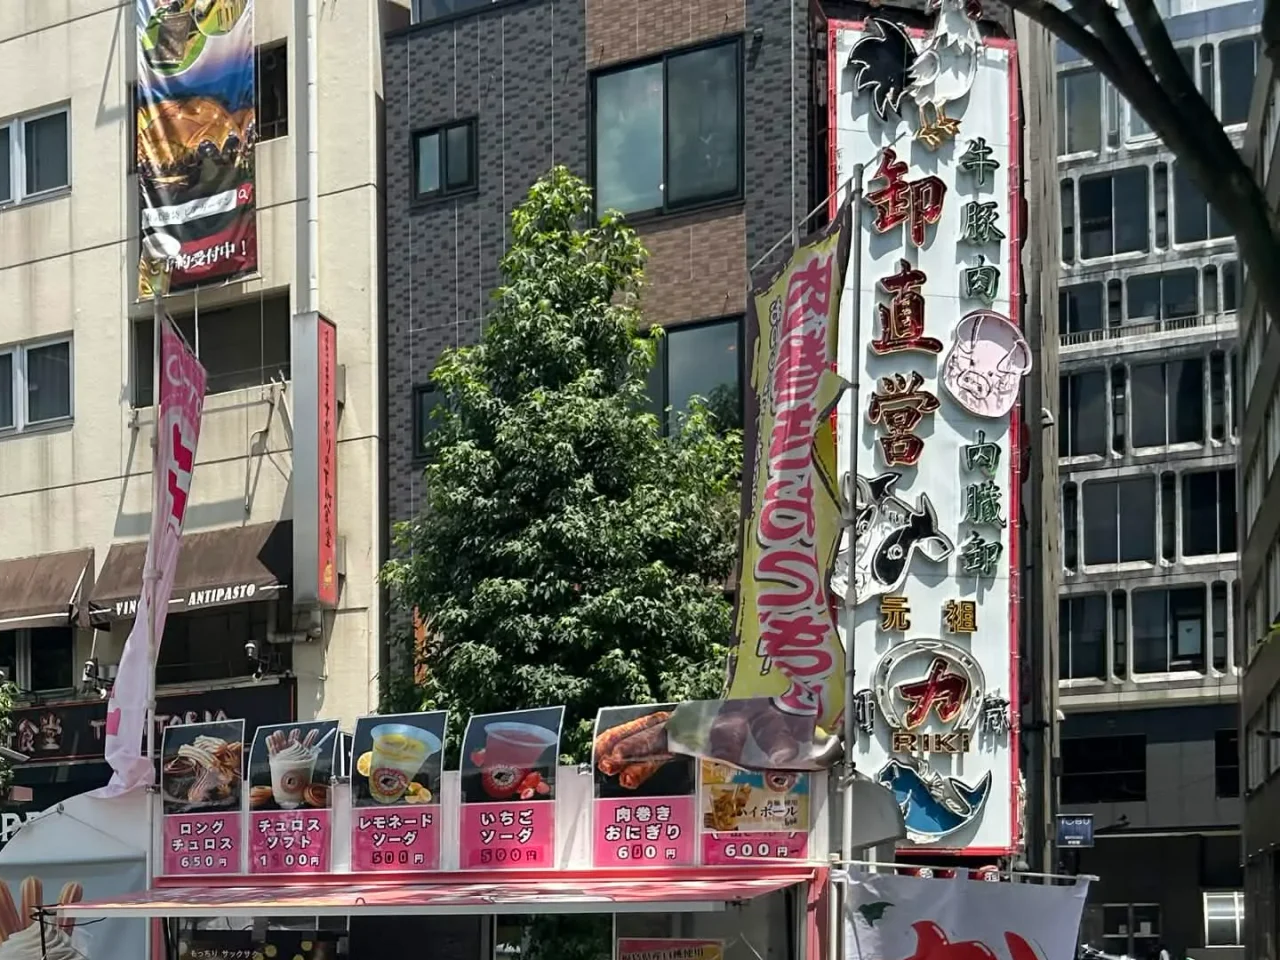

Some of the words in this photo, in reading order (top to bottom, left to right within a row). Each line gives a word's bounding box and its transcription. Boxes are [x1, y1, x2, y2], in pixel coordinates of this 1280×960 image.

[959, 137, 1006, 301] 牛豚肉
[866, 148, 948, 466] 卸直営
[116, 602, 139, 616] VIN
[188, 584, 256, 606] ANTIPASTO
[881, 597, 977, 632] 元祖
[900, 655, 970, 730] 力
[894, 732, 970, 752] RIKI
[358, 814, 433, 831] レモネード
[481, 808, 534, 826] いちご
[615, 806, 671, 822] 肉巻き
[180, 819, 224, 835] ロング
[258, 818, 320, 832] チュロス
[605, 823, 681, 841] おにぎり
[267, 835, 311, 850] ソフト
[373, 830, 418, 847] ソーダ
[481, 828, 534, 844] ソーダ
[172, 838, 233, 852] チュロス
[180, 855, 227, 868] 650円
